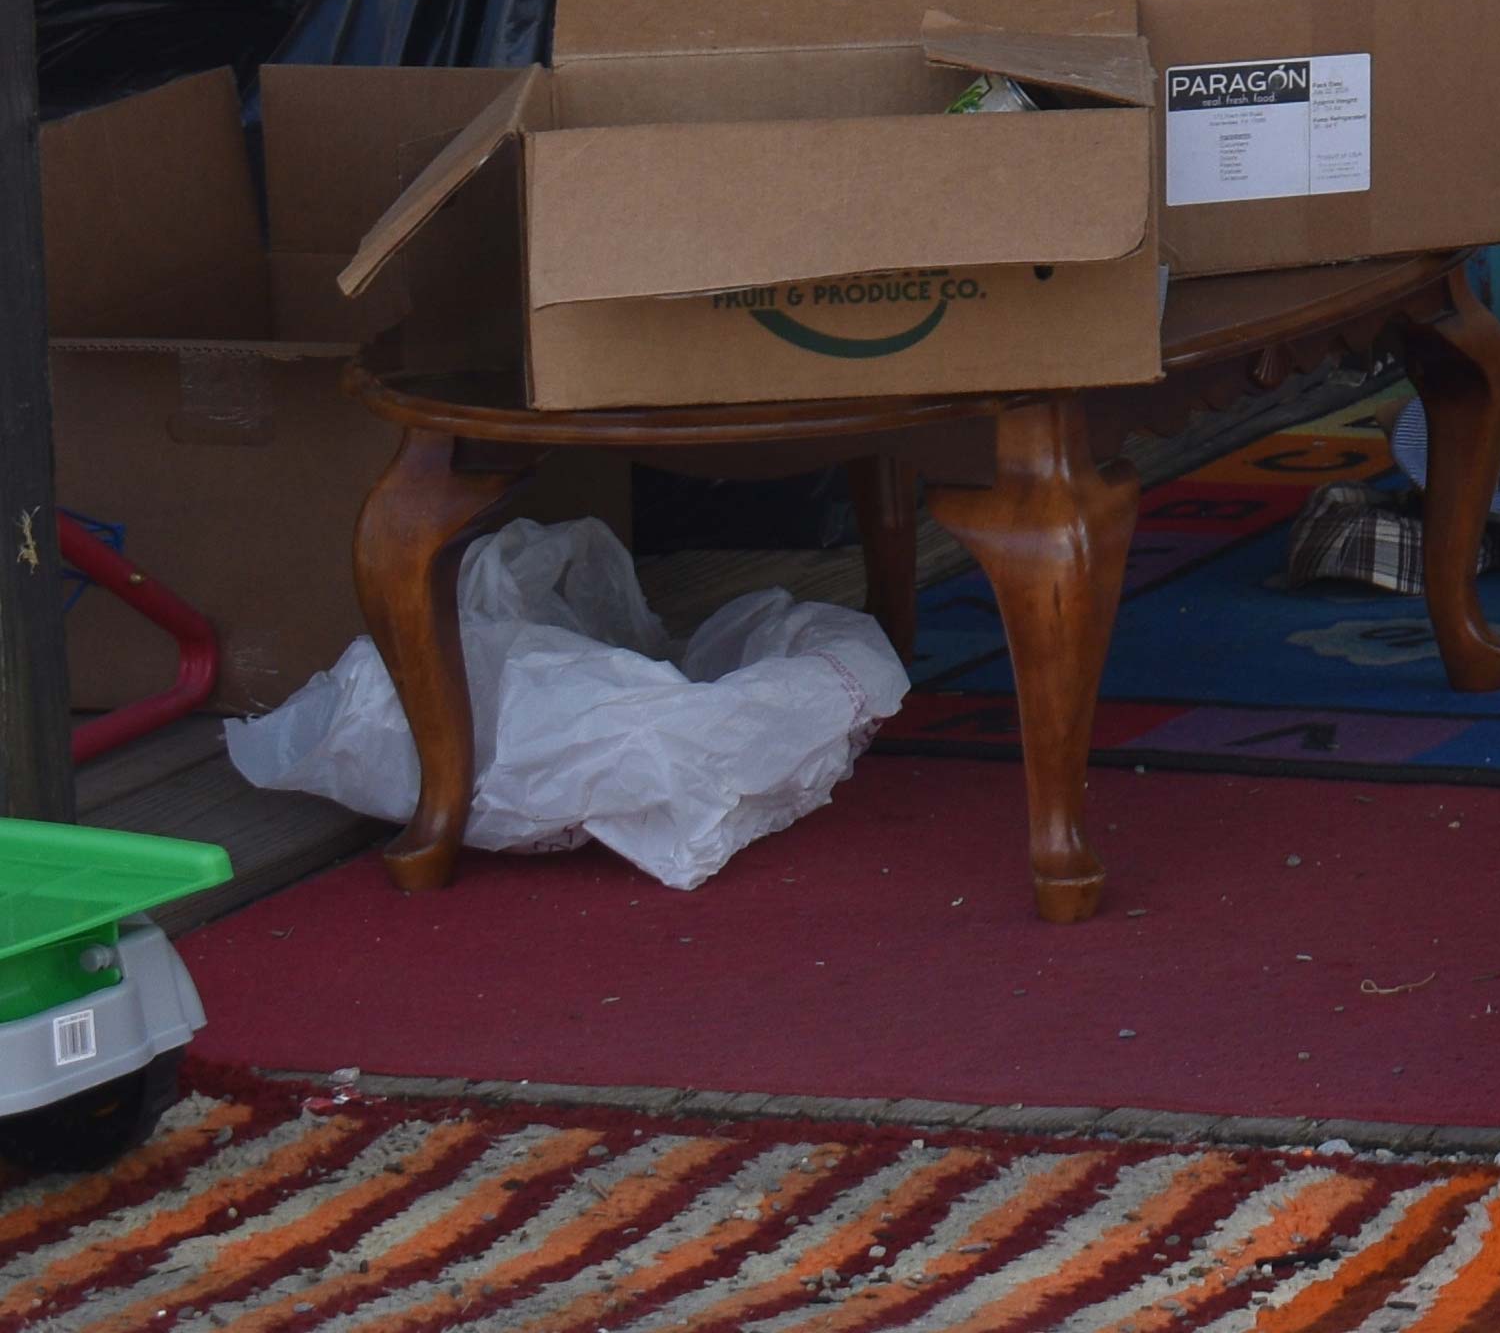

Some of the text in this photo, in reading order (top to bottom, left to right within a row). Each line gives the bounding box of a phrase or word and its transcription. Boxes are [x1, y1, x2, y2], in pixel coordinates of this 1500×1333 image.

[1172, 65, 1307, 97] PARAGON
[712, 279, 988, 310] FRUIT & PRODUCE CO.
